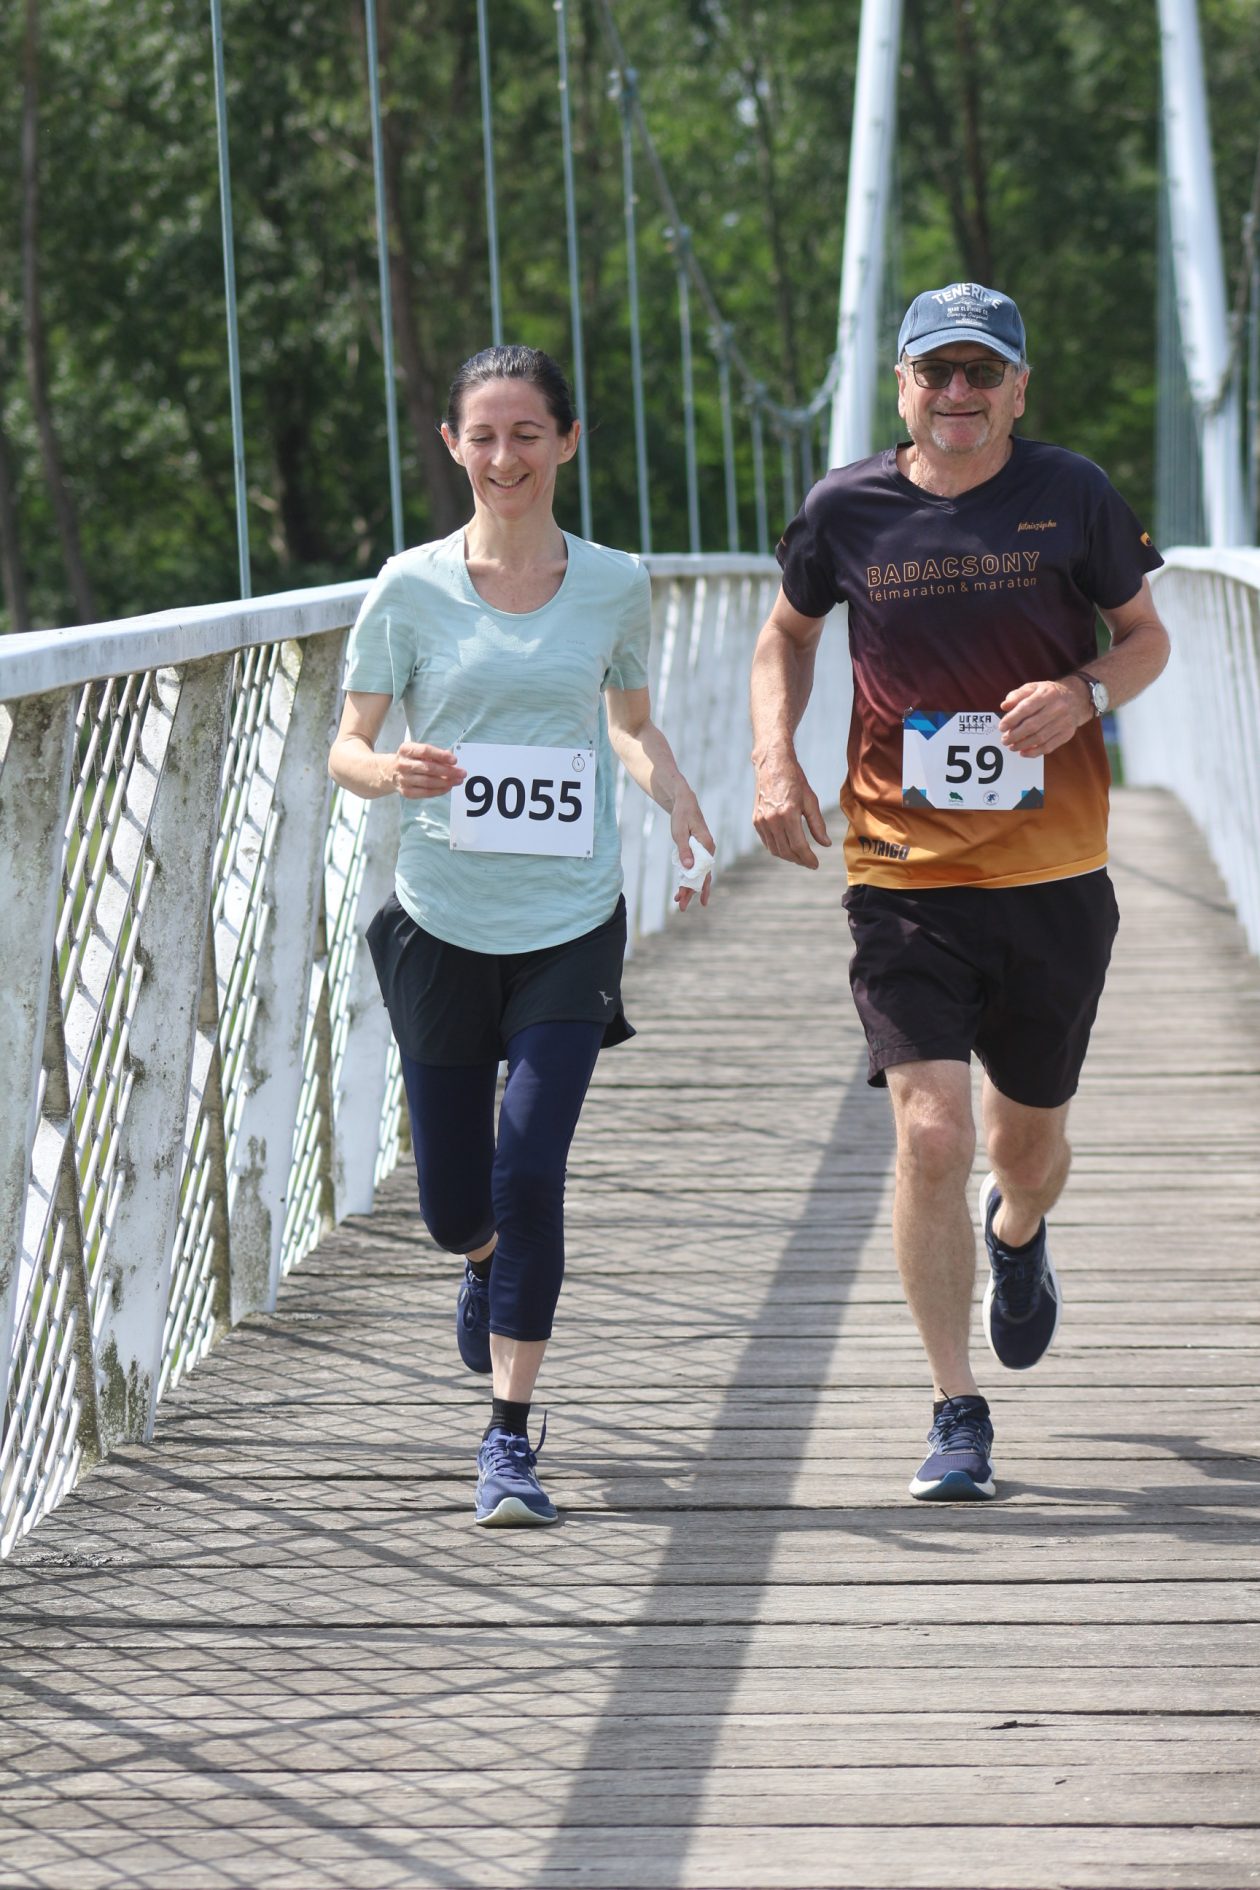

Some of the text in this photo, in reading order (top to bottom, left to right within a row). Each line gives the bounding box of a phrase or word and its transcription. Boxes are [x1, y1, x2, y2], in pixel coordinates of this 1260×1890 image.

[867, 552, 1040, 588] BADACSONY
[869, 576, 1037, 602] félmaraton & maraton
[945, 745, 1003, 785] 59
[464, 775, 582, 823] 9055
